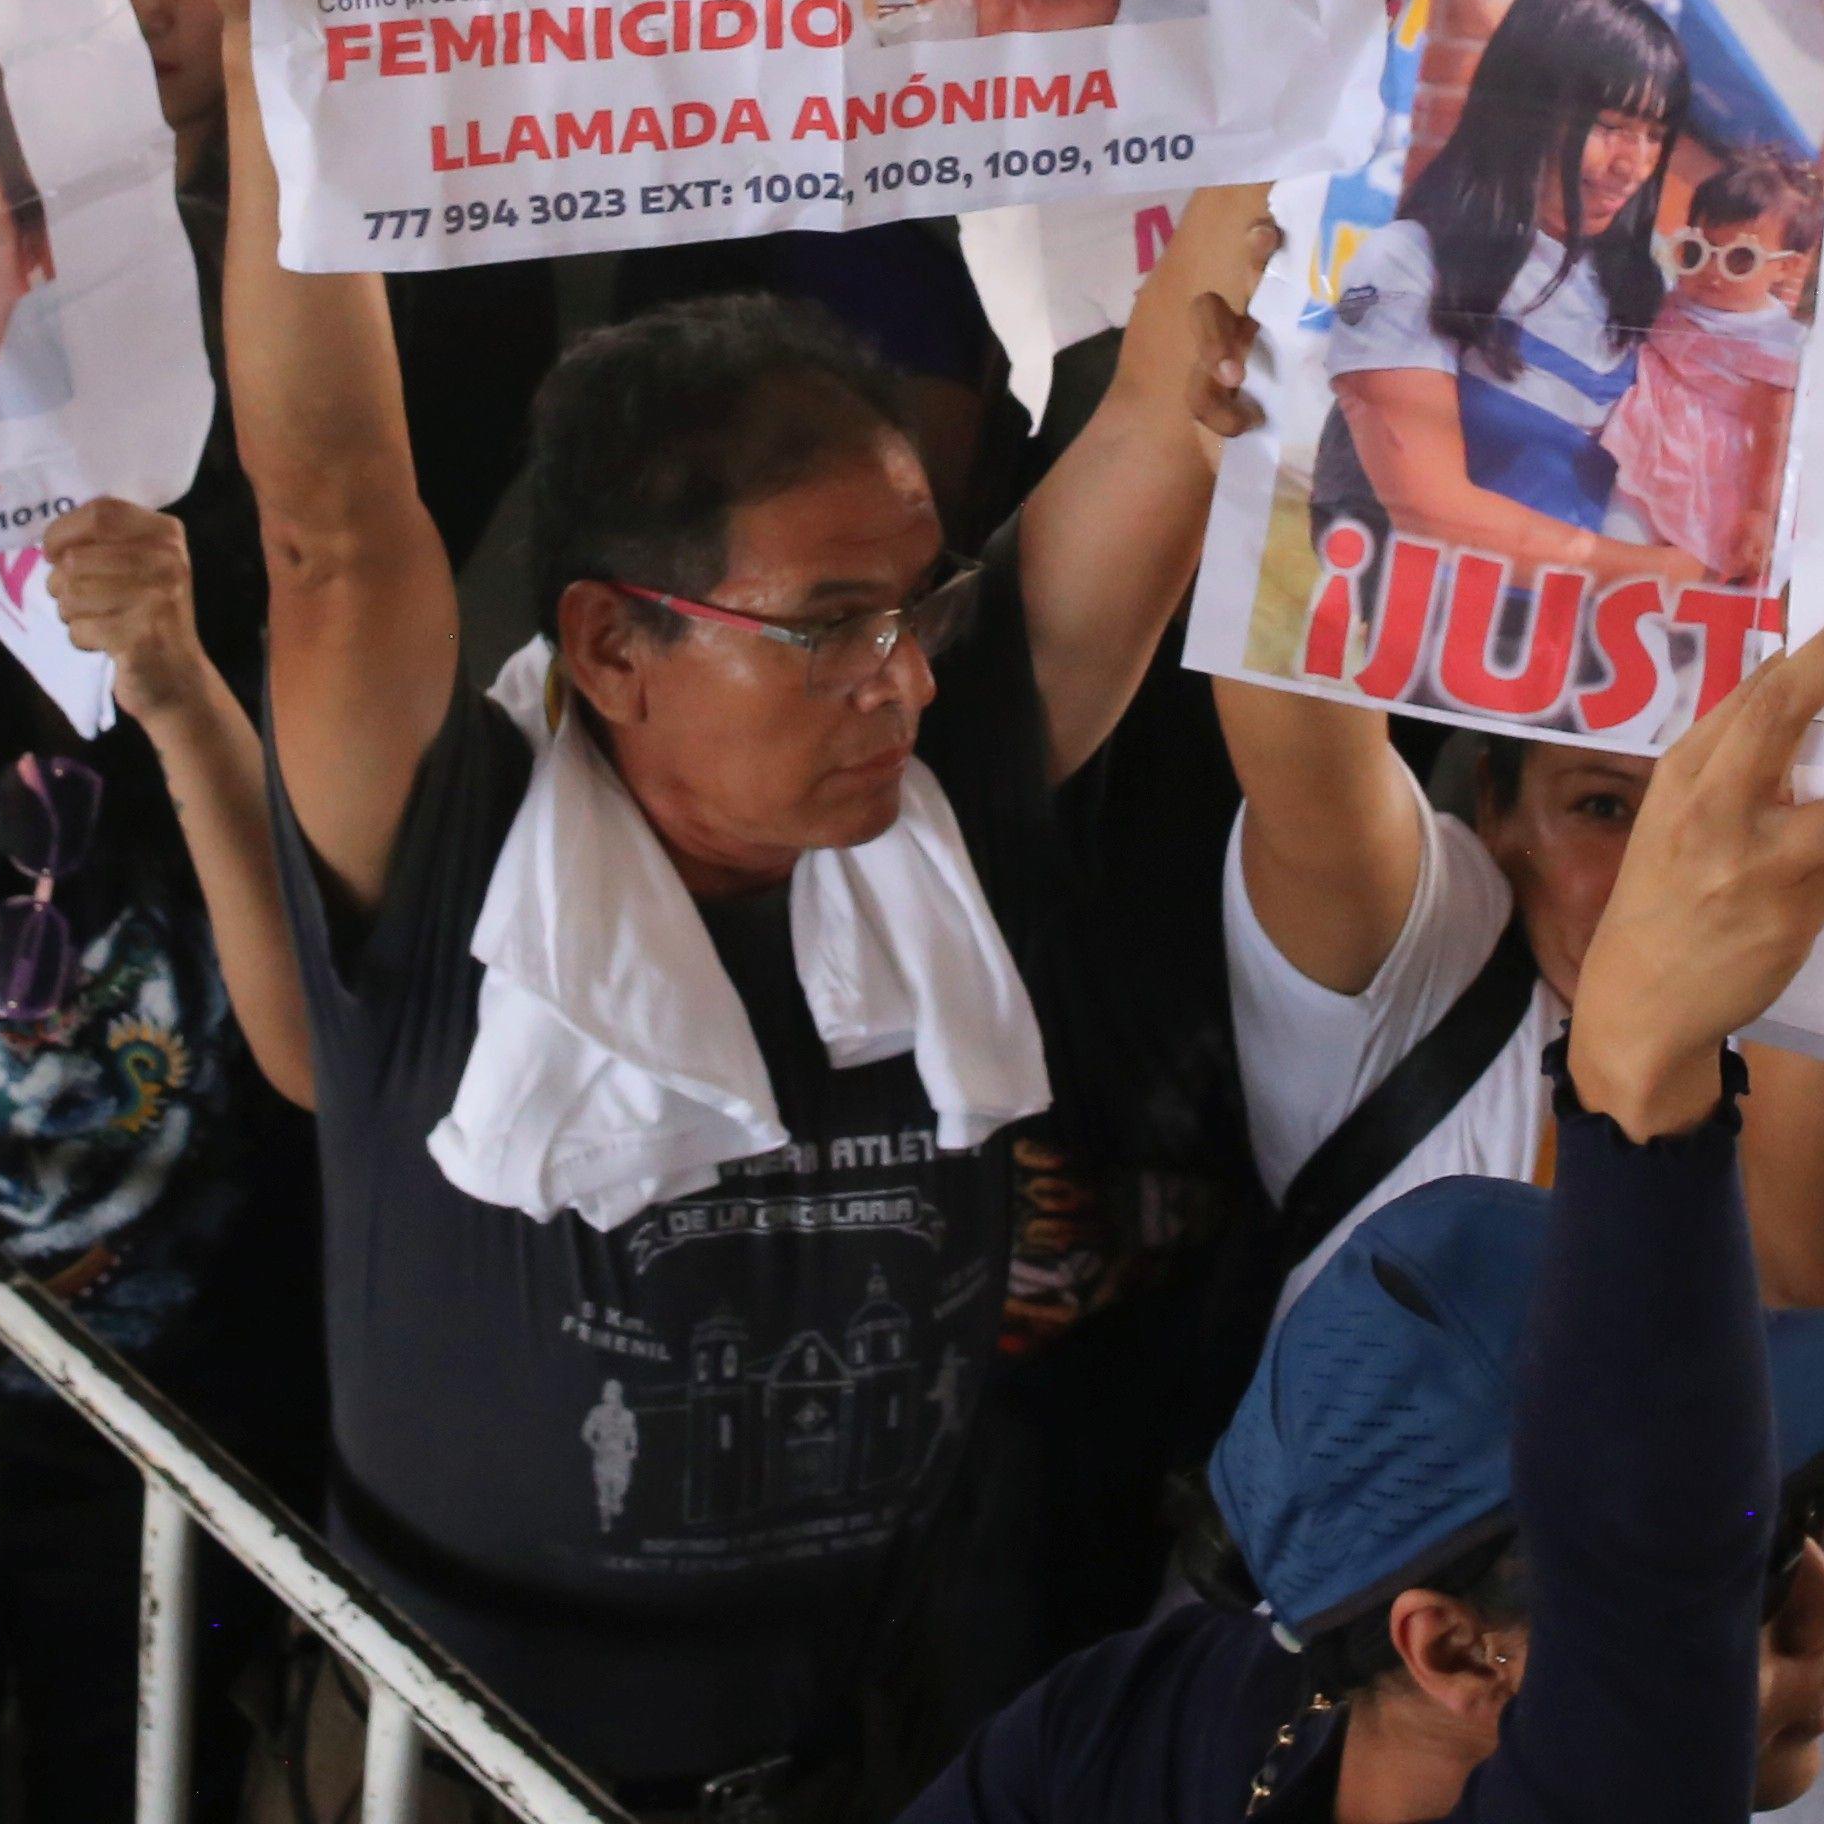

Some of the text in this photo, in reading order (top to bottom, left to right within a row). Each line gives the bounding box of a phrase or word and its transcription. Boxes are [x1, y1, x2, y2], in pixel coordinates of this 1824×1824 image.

[429, 67, 1119, 173] LLAMADA ANÓNIMA
[363, 132, 1196, 242] 777 994 3023 EXT: 1002, 1008, 1009, 1010
